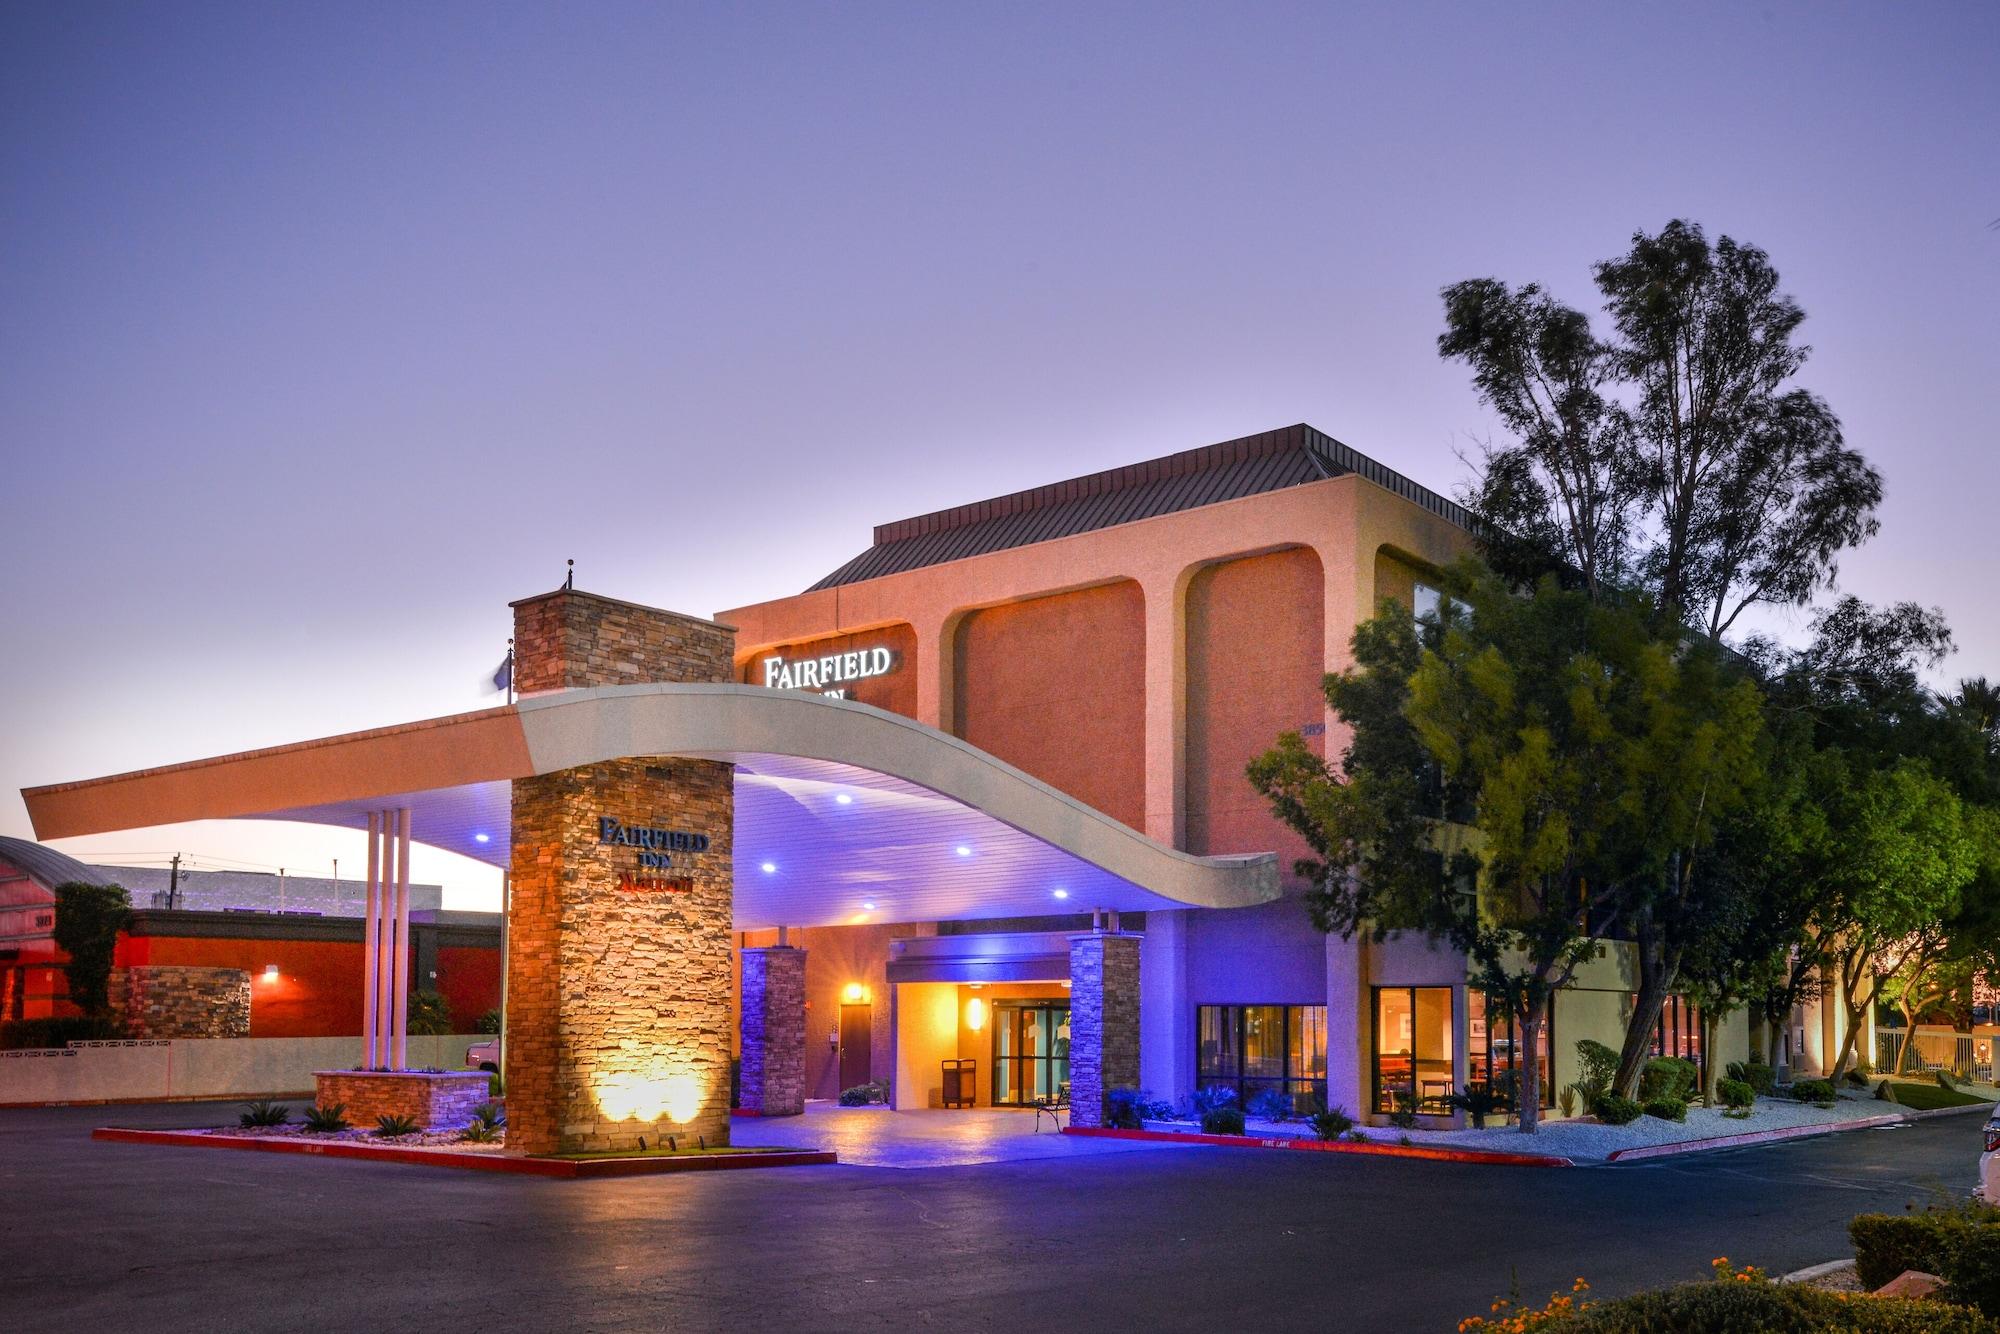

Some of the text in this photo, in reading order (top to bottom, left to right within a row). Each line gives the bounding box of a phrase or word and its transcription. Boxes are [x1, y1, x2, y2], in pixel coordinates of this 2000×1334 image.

[763, 647, 891, 688] FAIRFIELD
[599, 815, 709, 851] FAIRFIELD
[639, 852, 672, 868] INN
[1262, 1140, 1290, 1149] FIRE LANE
